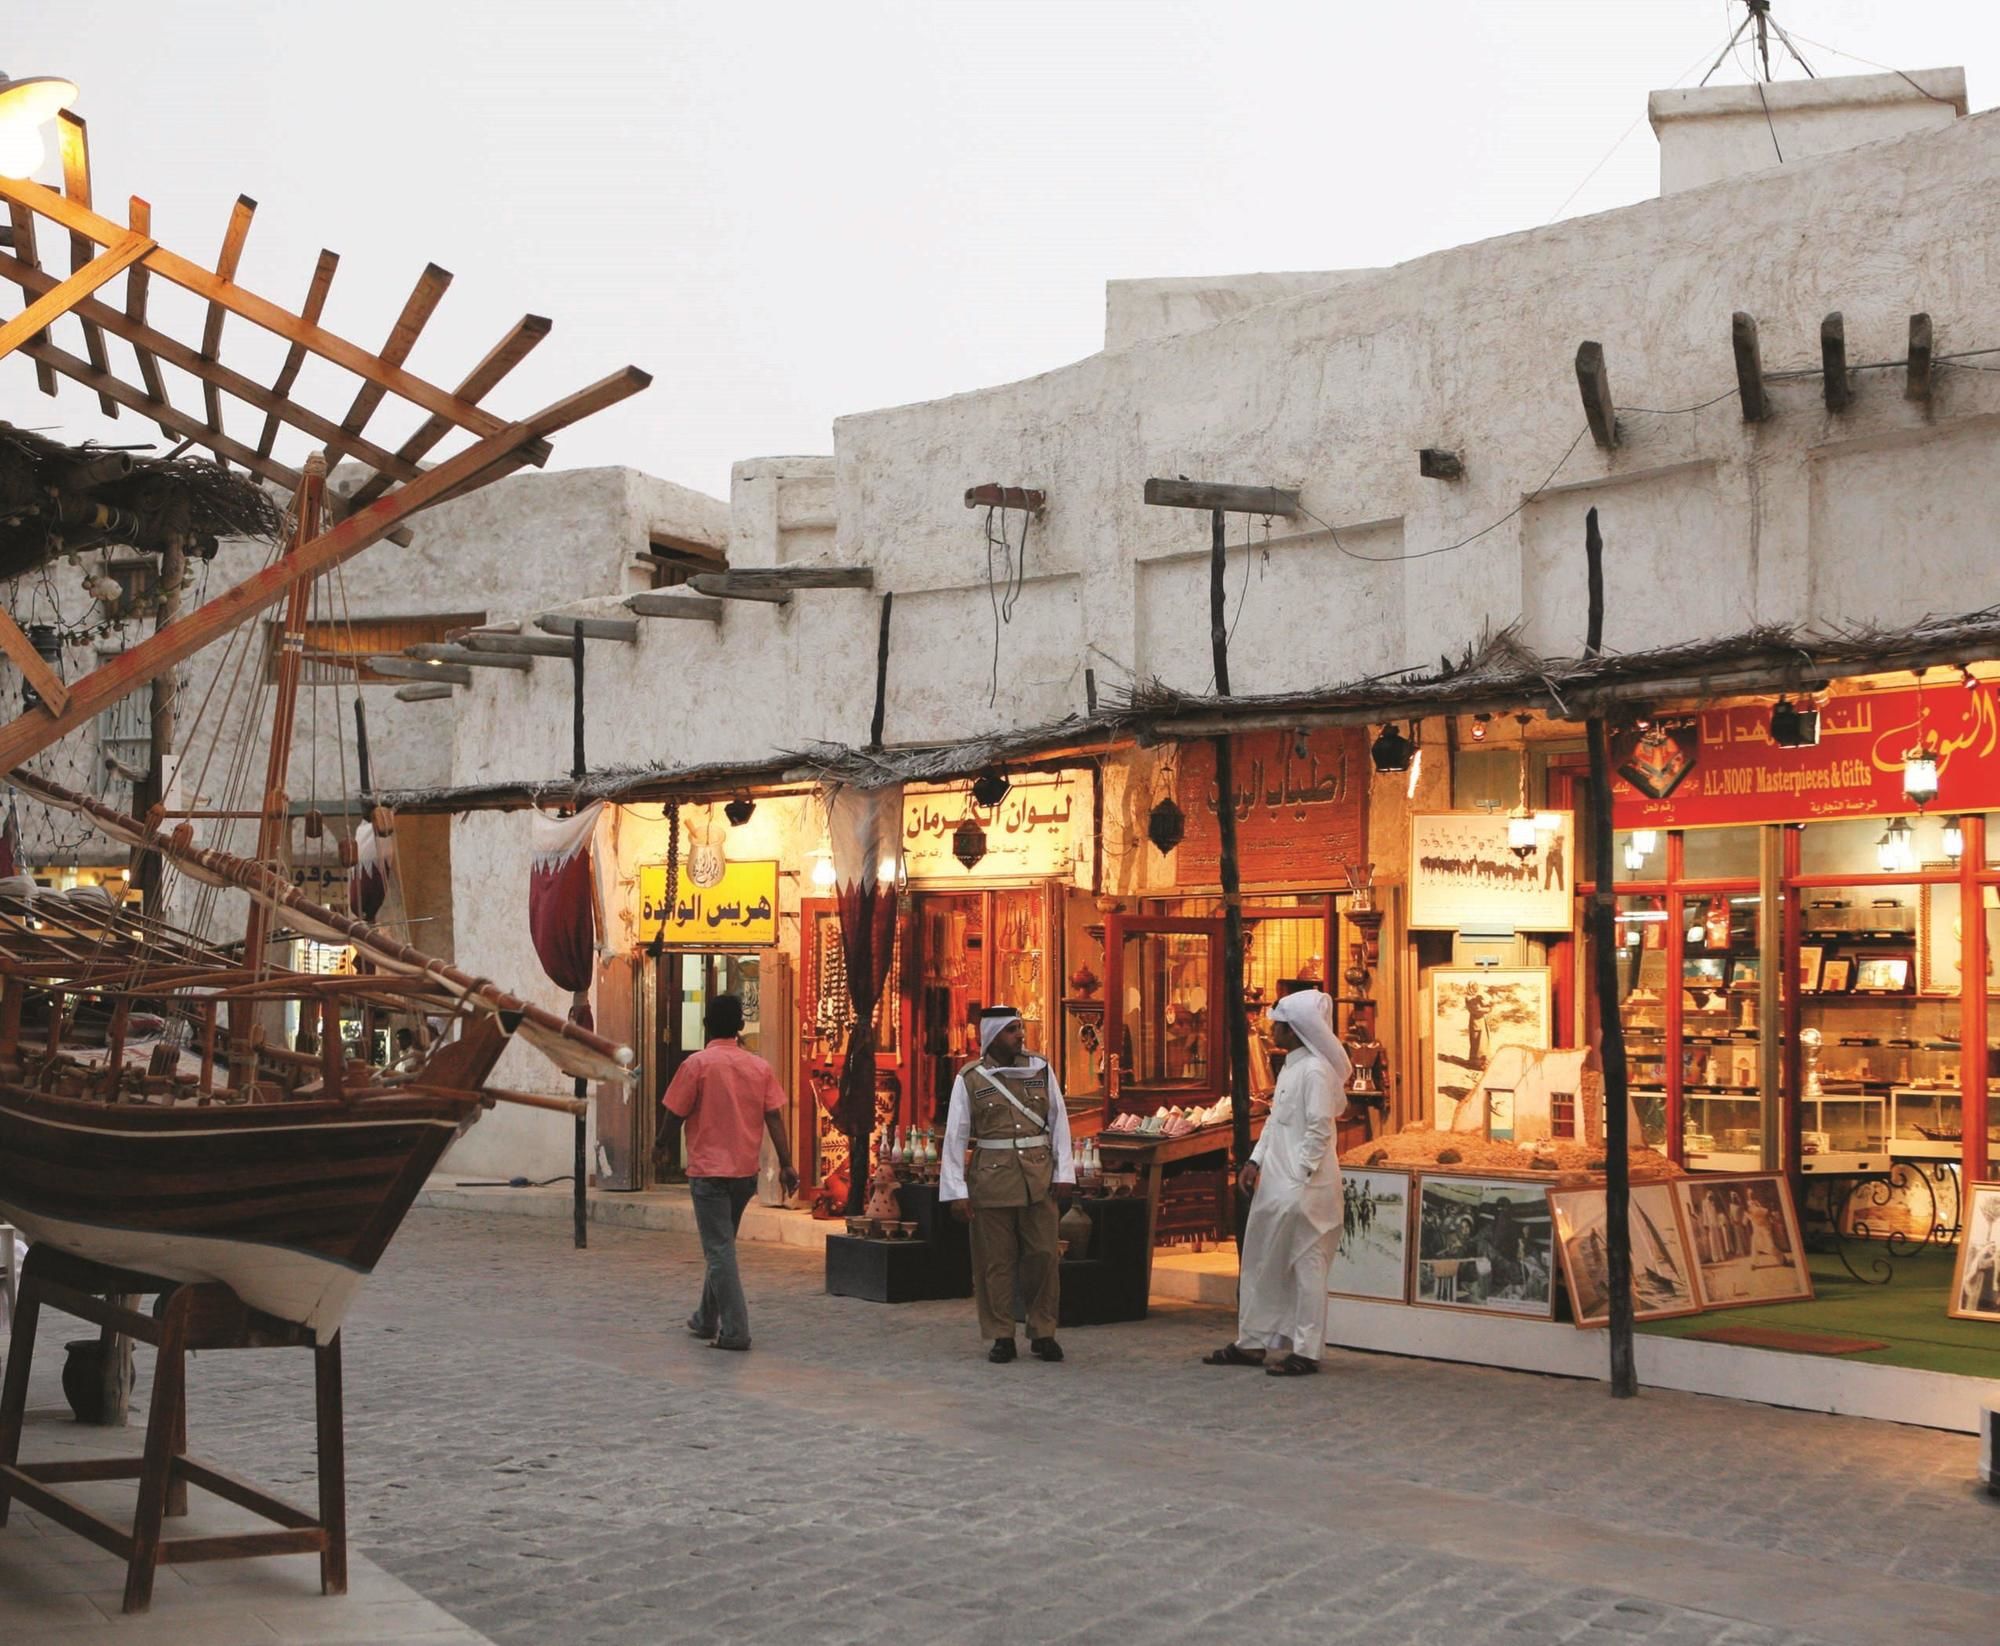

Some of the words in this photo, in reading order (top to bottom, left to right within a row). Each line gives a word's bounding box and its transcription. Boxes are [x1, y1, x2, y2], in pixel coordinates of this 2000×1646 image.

[1703, 766, 1753, 796] AL-NOOF
[1756, 763, 1830, 798] Masterpieces
[1831, 760, 1840, 787] &
[1841, 759, 1872, 787] Gifts
[1006, 794, 1073, 833] ليوان
[706, 895, 772, 928] هريس
